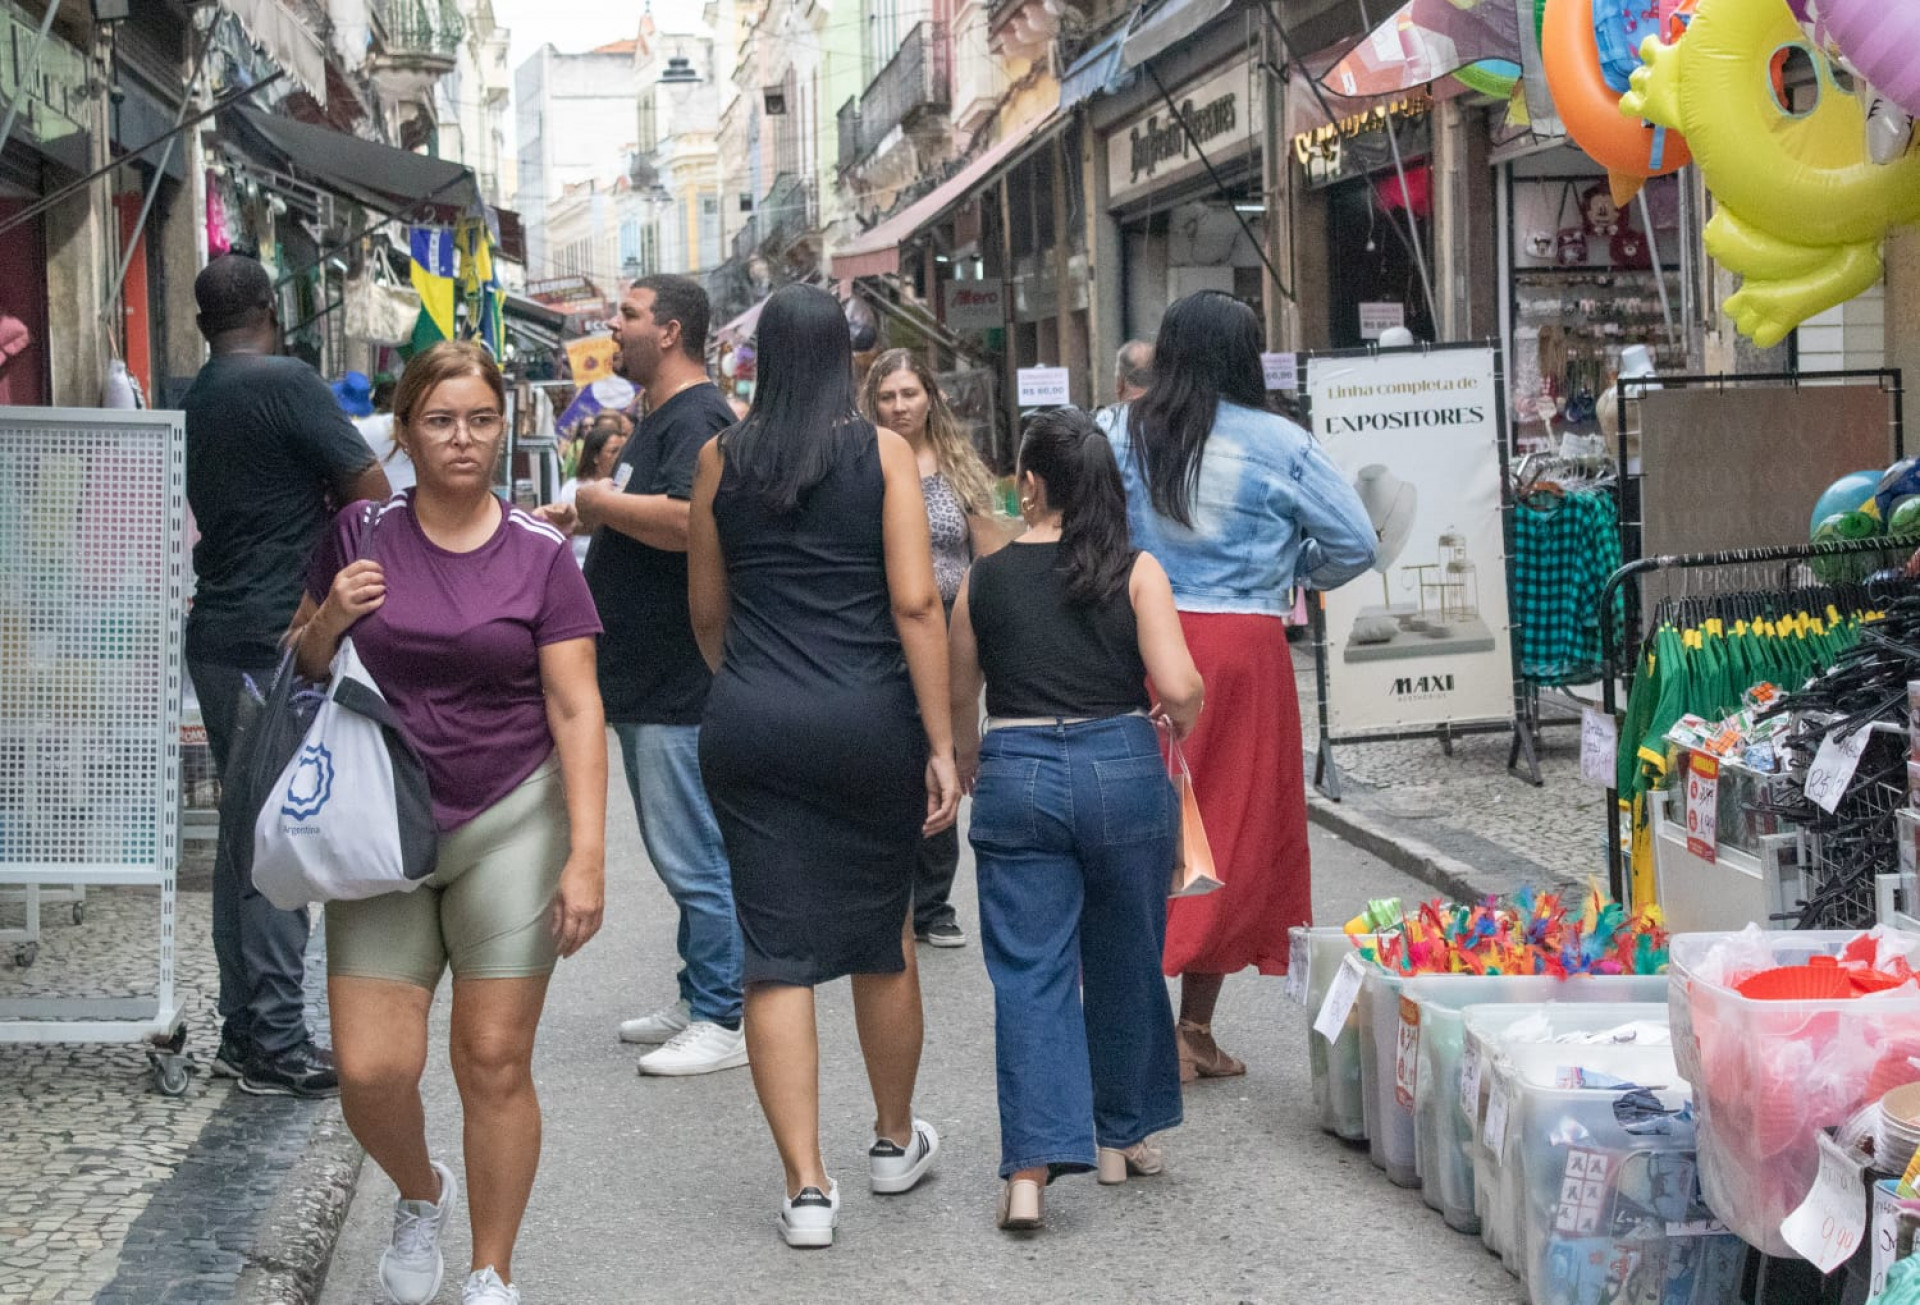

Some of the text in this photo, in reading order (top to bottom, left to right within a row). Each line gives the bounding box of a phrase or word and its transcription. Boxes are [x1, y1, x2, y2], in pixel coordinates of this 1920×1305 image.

[1327, 377, 1478, 399] Linha completa de
[1325, 406, 1485, 434] EXPOSITORES
[1389, 675, 1455, 695] MAXI
[282, 824, 321, 837] Argentina
